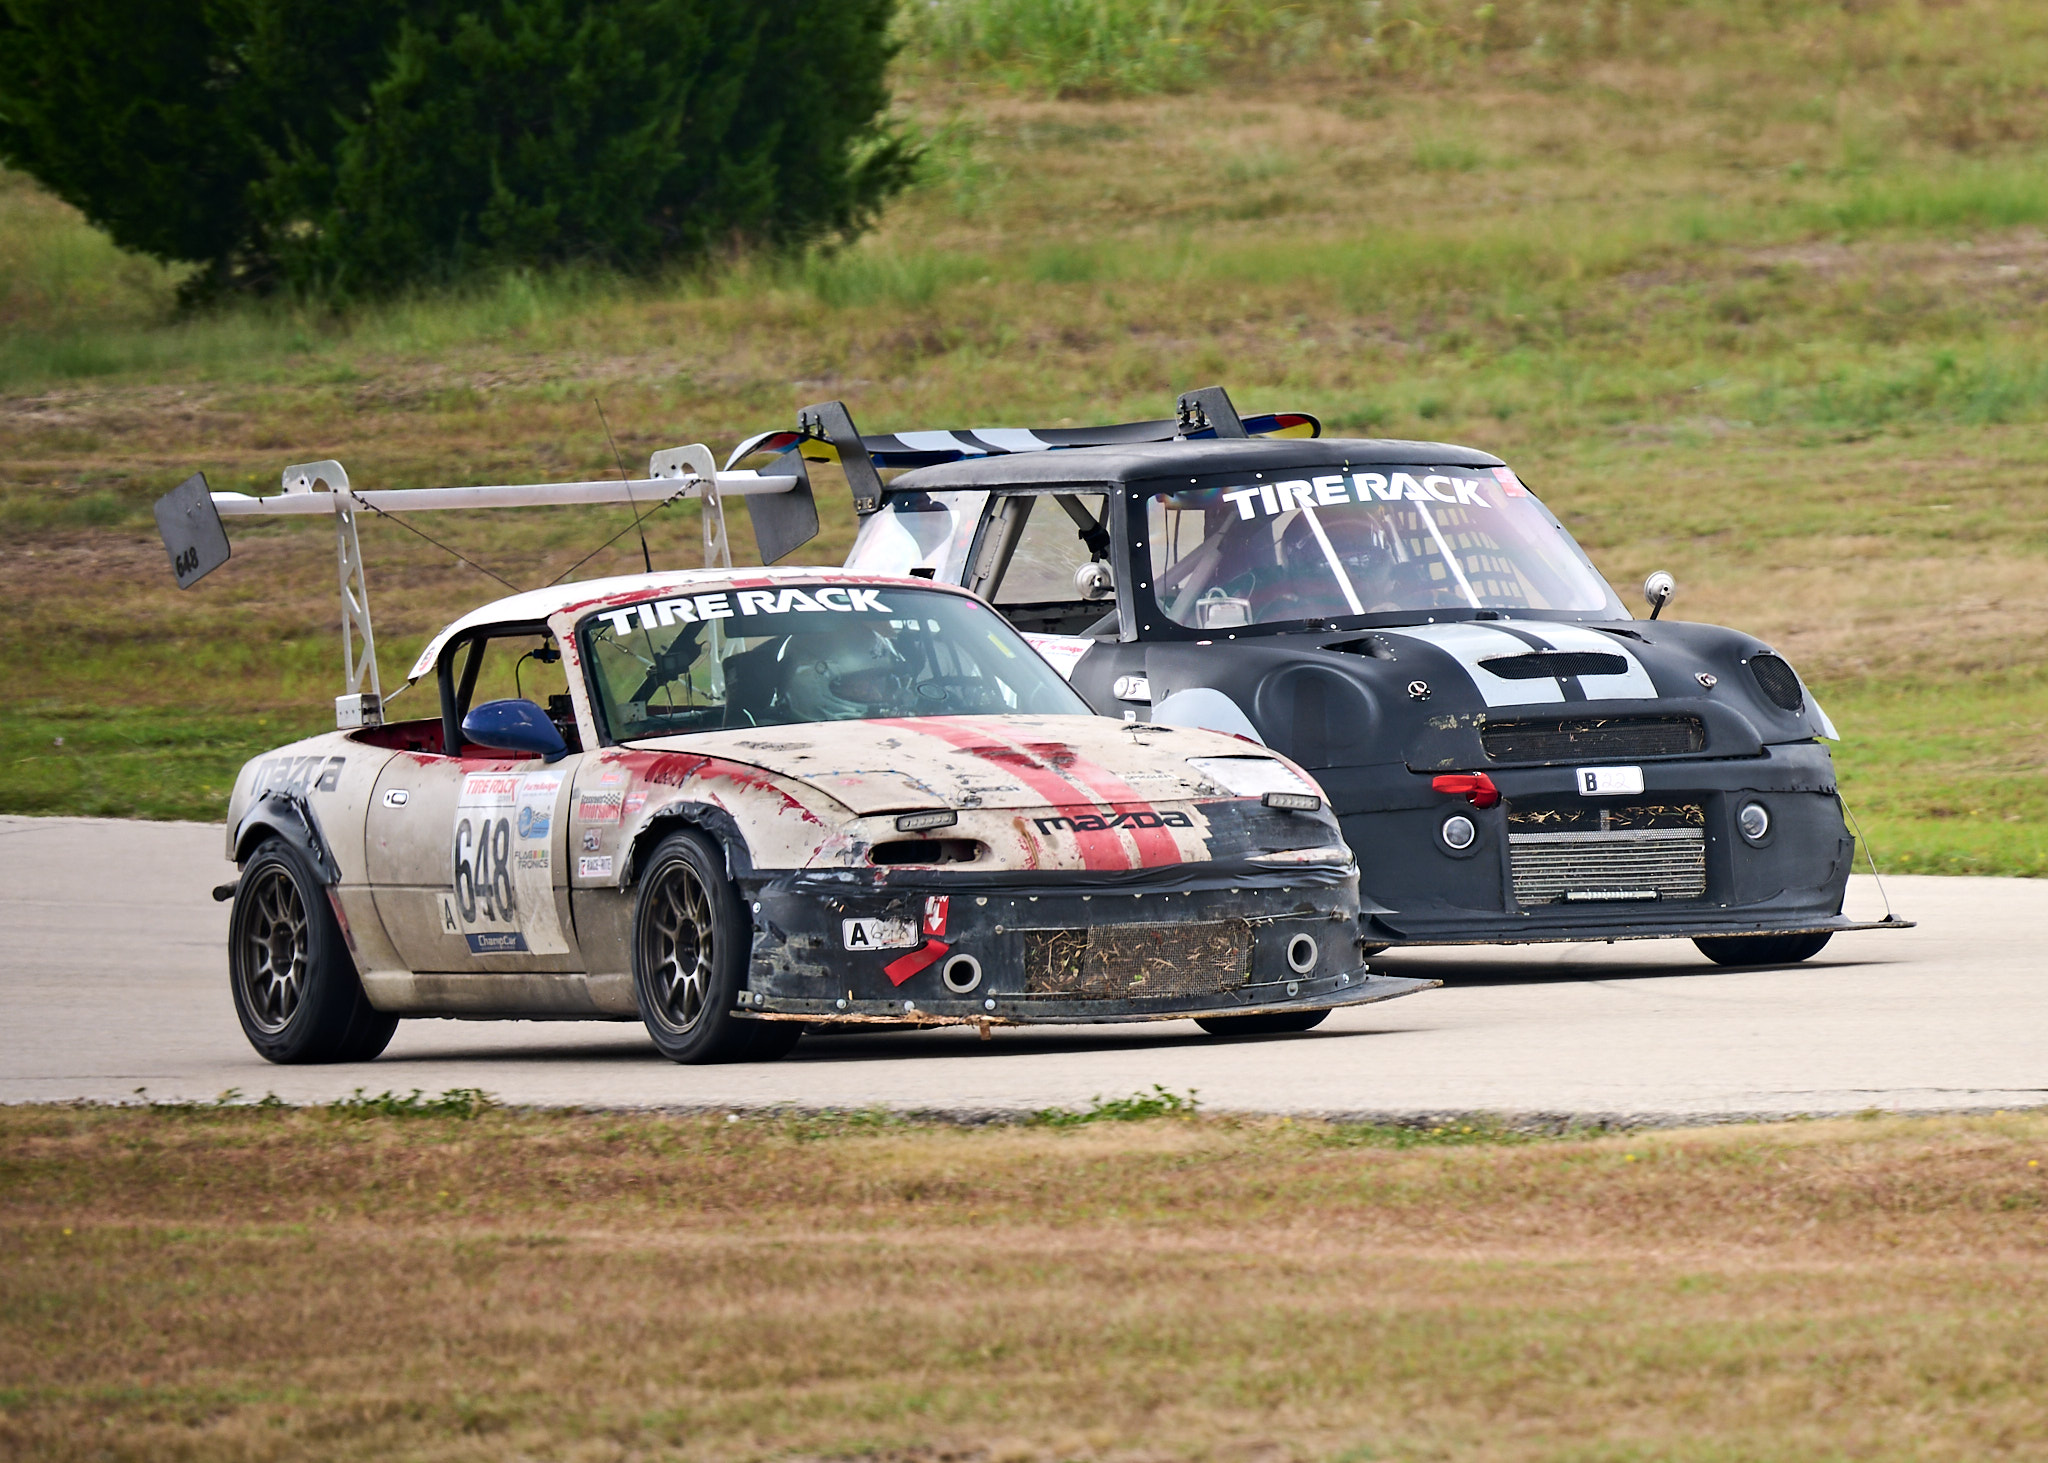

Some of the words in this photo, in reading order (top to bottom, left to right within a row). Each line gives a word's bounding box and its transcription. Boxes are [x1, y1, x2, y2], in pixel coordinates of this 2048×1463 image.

[1223, 475, 1350, 520] TIRE
[1353, 472, 1491, 508] RACK
[175, 546, 199, 577] 648
[598, 594, 734, 636] TIRE
[737, 588, 893, 616] RACK
[466, 779, 490, 794] TIRE
[489, 778, 519, 801] RACK
[1585, 772, 1597, 791] B
[515, 850, 533, 860] FLAG
[518, 859, 549, 869] TRONICS
[455, 817, 513, 923] 648
[444, 898, 457, 930] A
[478, 934, 516, 950] ChampCar
[850, 922, 869, 946] A
